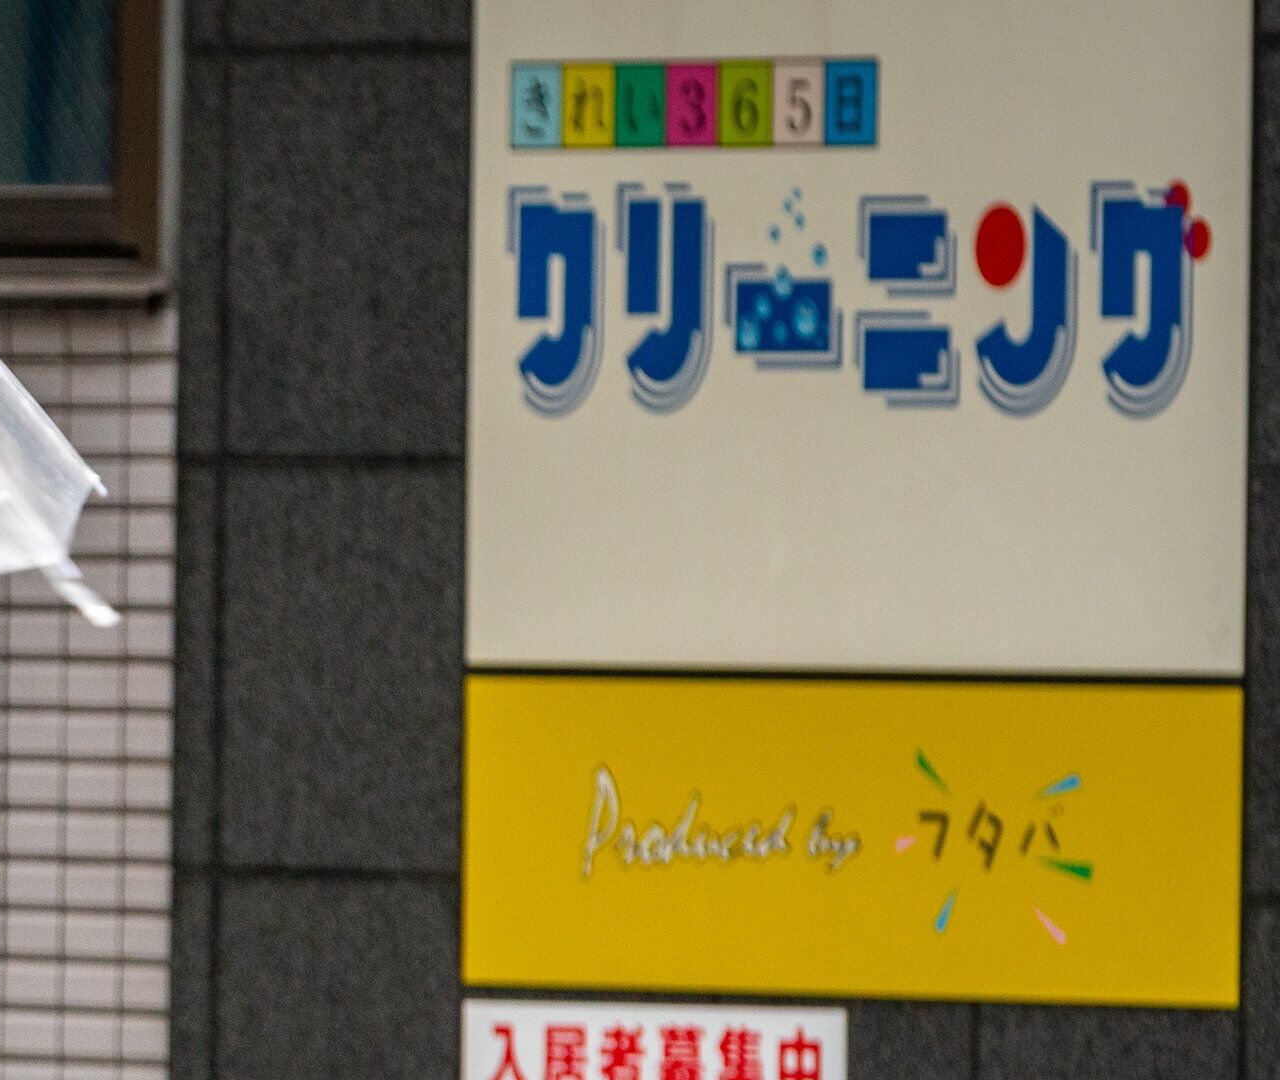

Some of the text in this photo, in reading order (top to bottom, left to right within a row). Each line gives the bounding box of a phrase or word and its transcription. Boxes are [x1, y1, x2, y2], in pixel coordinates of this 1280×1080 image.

[507, 179, 1212, 418] クリーニング
[581, 763, 797, 879] Produced
[916, 800, 1065, 870] フタバ
